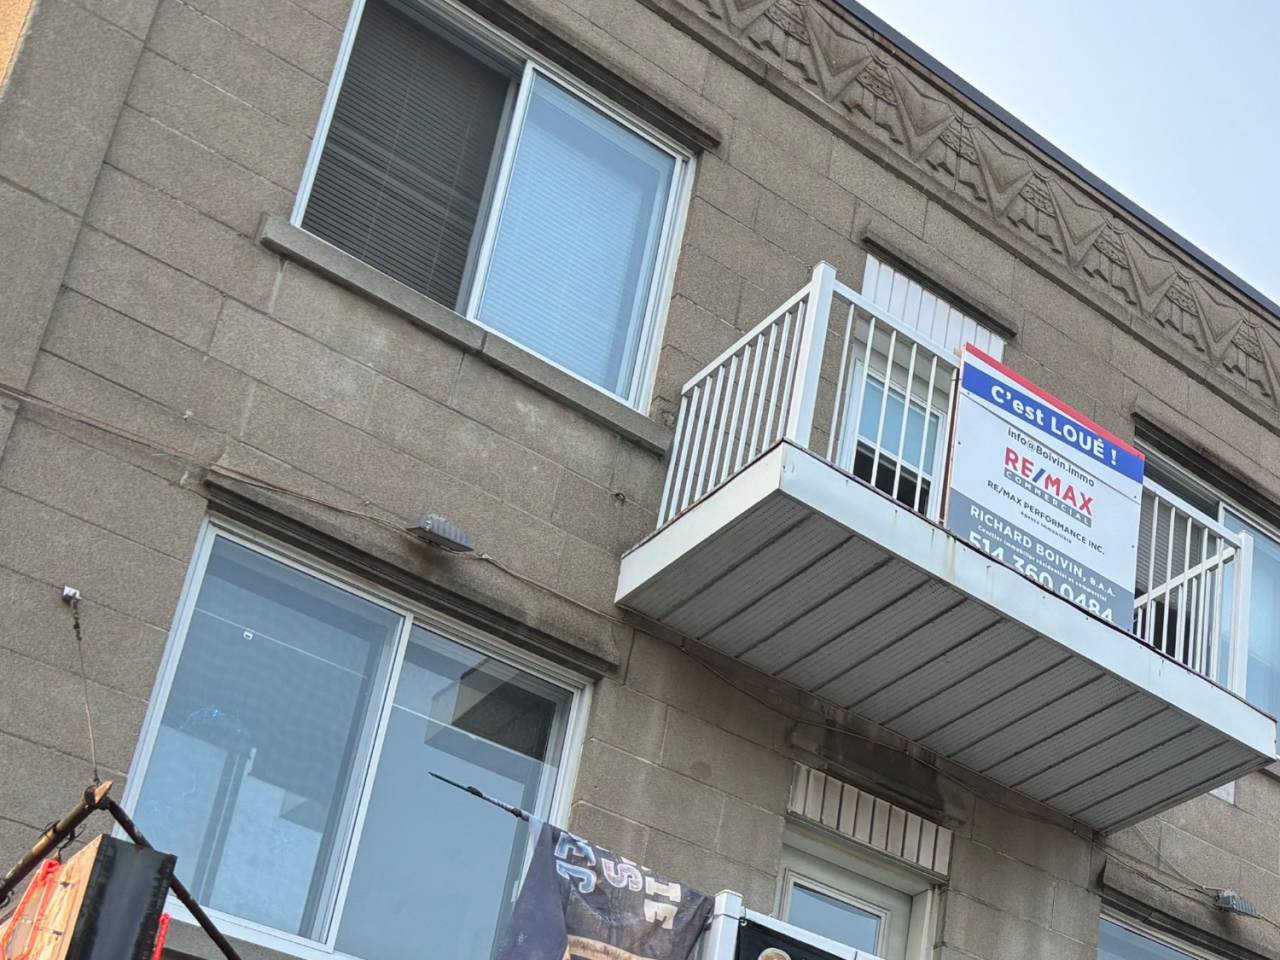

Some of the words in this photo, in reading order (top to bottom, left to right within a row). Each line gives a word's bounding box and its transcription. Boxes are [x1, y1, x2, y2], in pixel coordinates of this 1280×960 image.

[1007, 427, 1095, 487] info@Boivin.immo
[1051, 416, 1105, 459] LOUÉ
[1111, 448, 1117, 466] !
[1005, 447, 1093, 517] RE/MAX
[1005, 470, 1090, 526] COMMERCIAL
[970, 505, 1032, 548] RICHARD
[1036, 545, 1086, 583] BOIVIN,
[987, 480, 1022, 507] RE/MAX
[1023, 502, 1088, 544] PERFORMANCE
[1088, 541, 1105, 555] INC.
